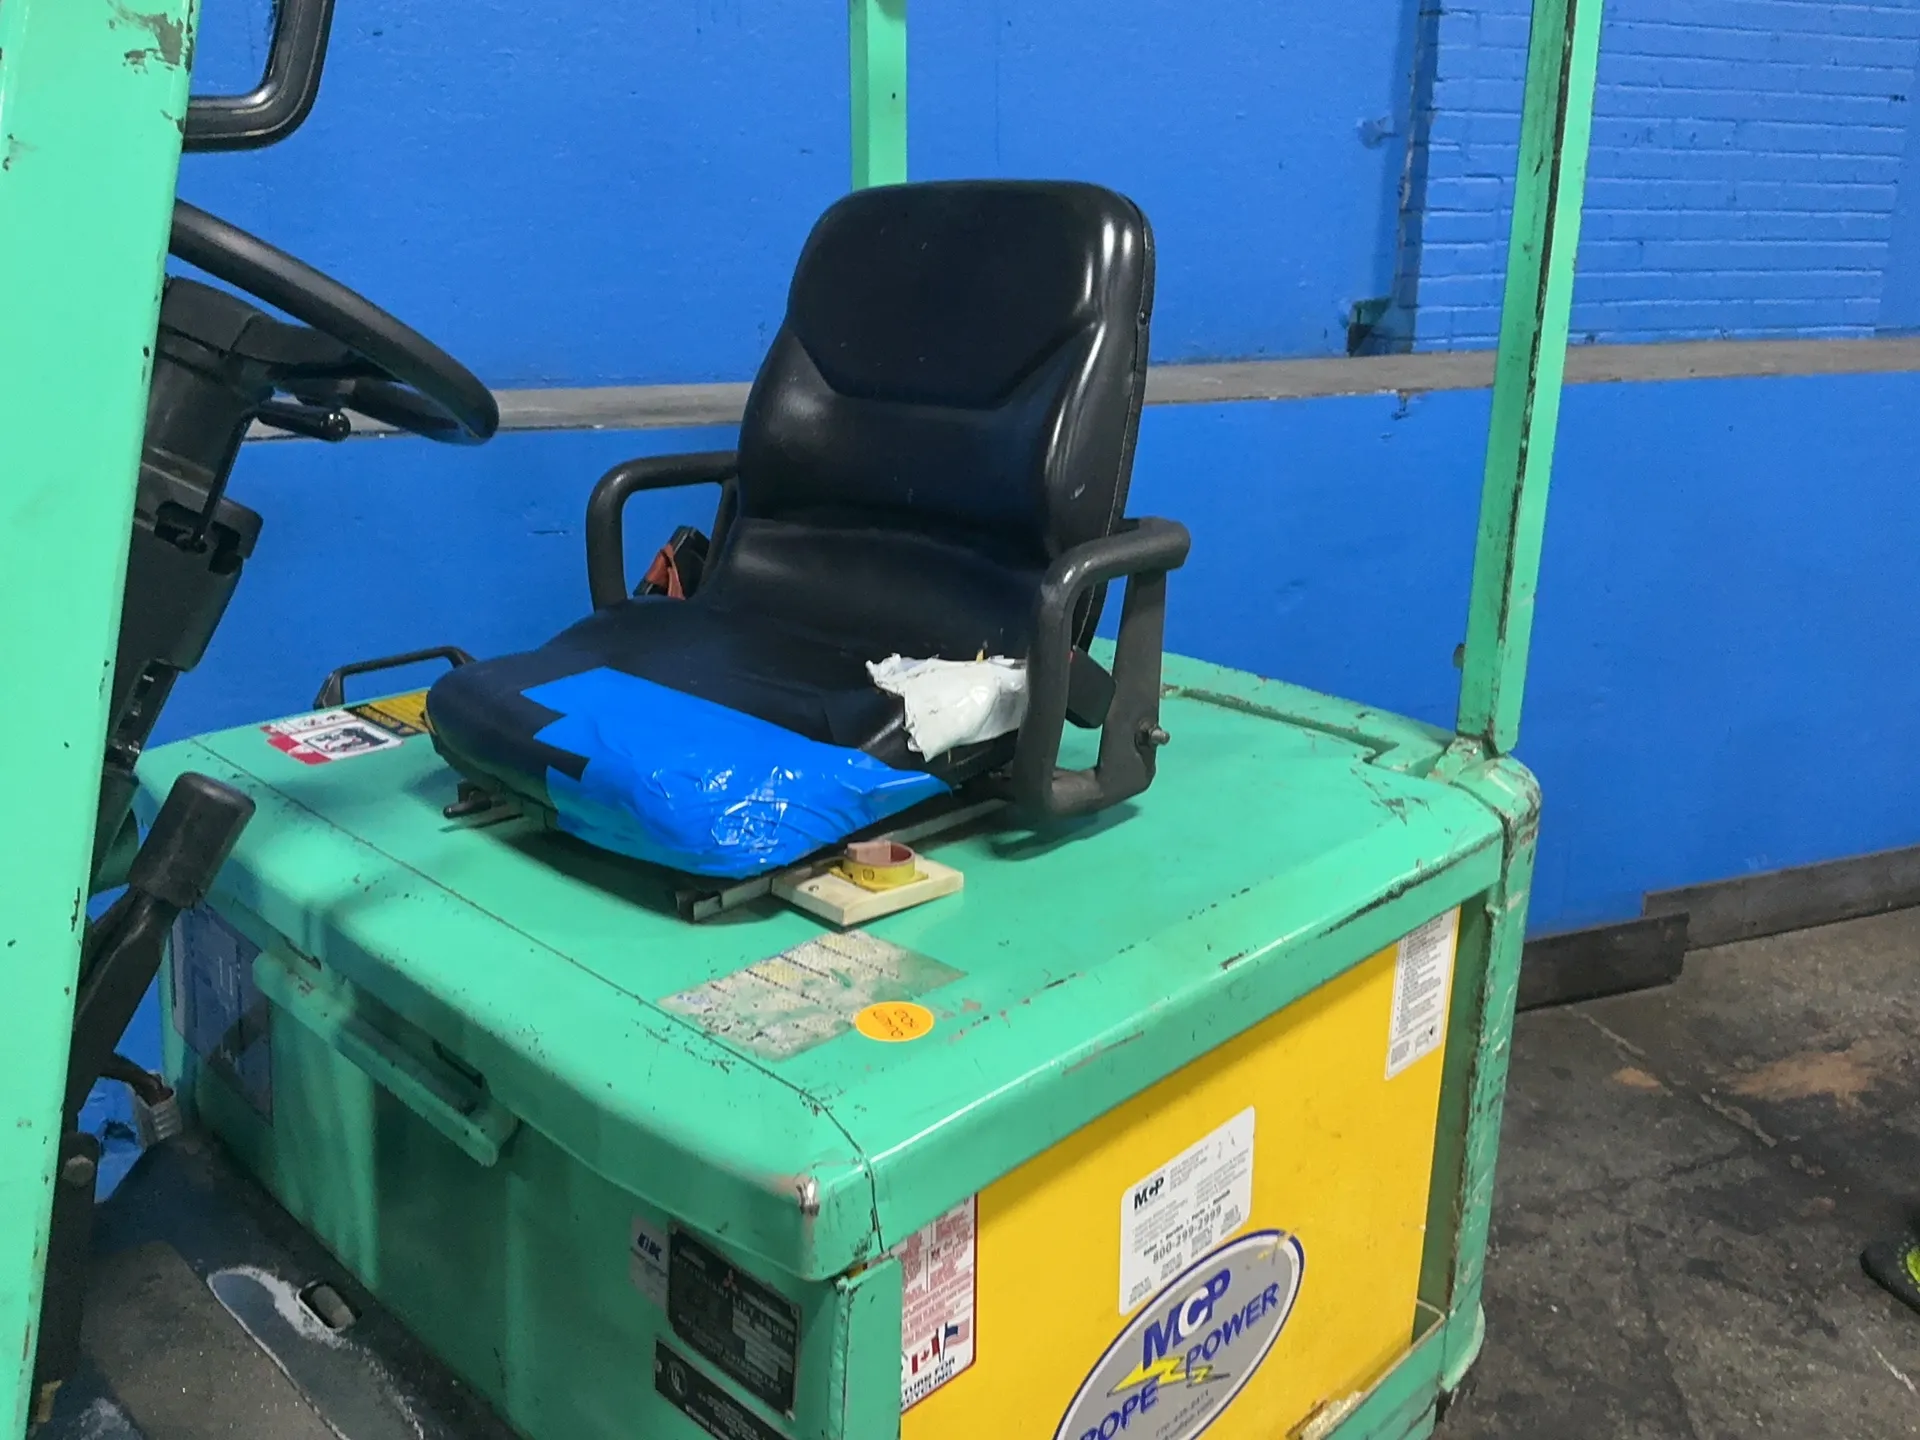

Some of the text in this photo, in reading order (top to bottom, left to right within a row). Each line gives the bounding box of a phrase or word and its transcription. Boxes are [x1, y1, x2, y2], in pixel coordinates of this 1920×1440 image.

[1153, 1204, 1222, 1264] 800-299-2999
[1143, 1268, 1231, 1372] MCP
[1186, 1282, 1279, 1380] POWER
